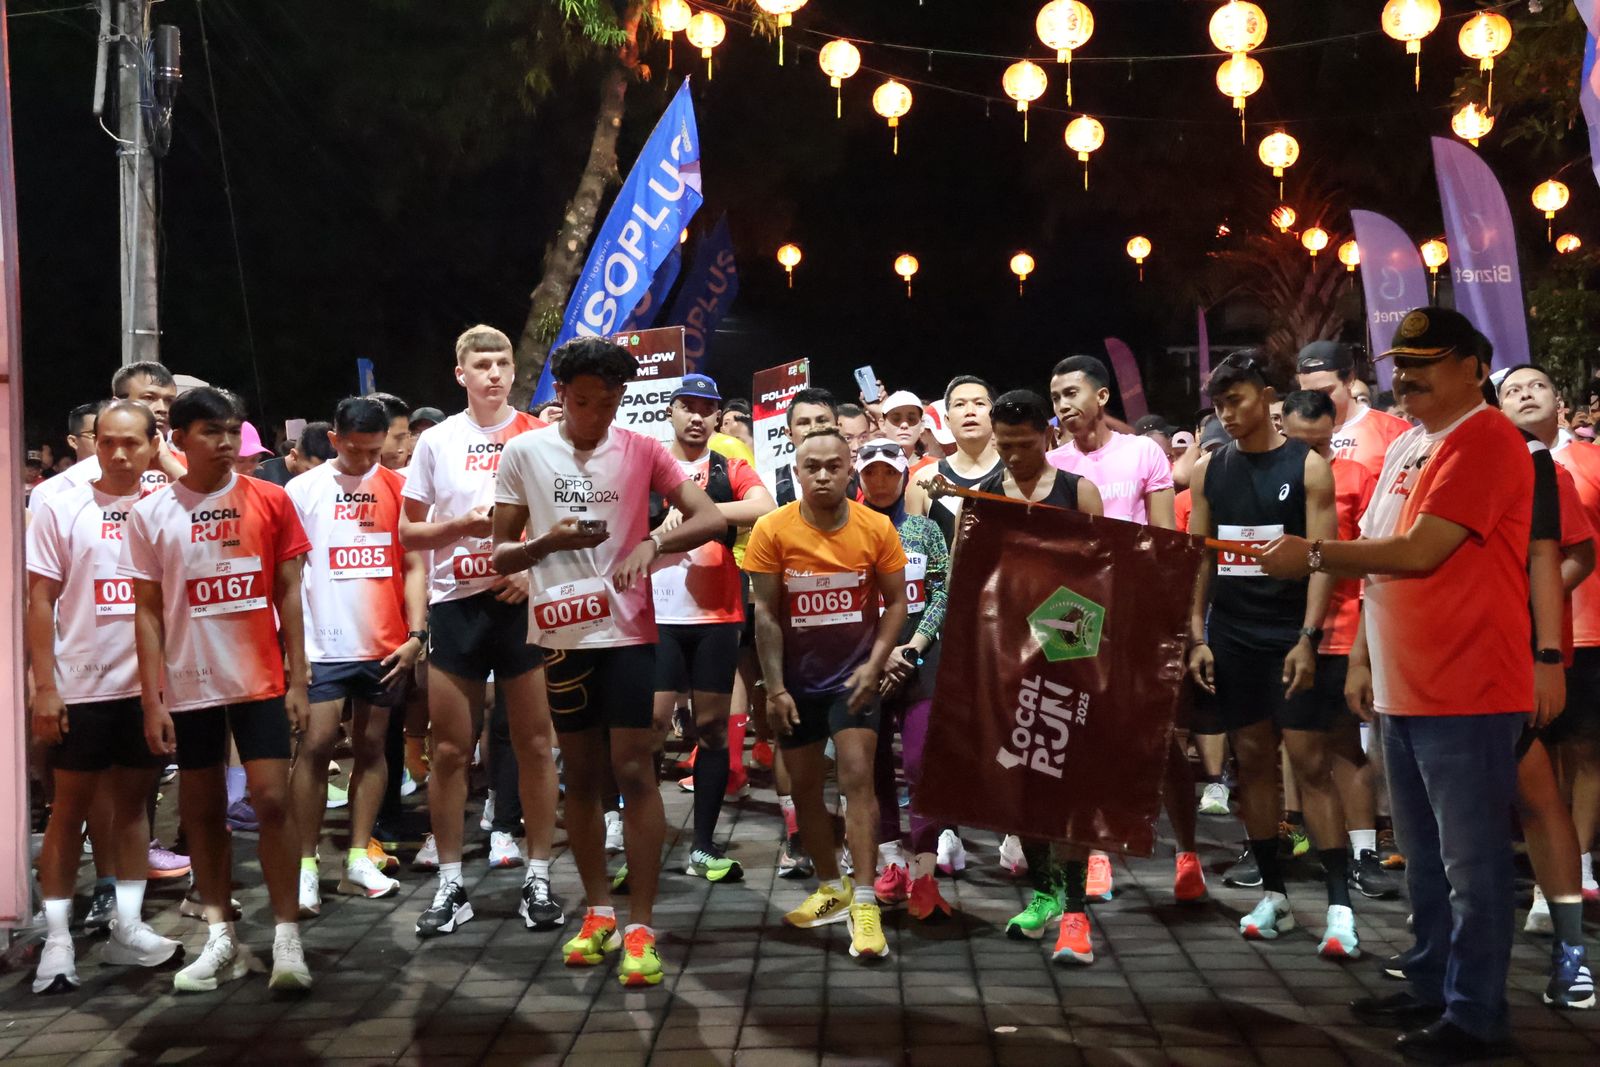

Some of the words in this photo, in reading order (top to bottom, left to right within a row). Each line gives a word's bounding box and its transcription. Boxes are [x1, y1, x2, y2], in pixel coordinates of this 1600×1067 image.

[635, 351, 676, 365] LLOW
[636, 366, 659, 377] ME
[620, 391, 672, 407] PACE
[761, 382, 808, 403] FOLLOW
[767, 425, 787, 441] PA
[467, 443, 504, 454] LOCA
[772, 441, 796, 457] 7.0
[1330, 438, 1358, 448] CAL
[554, 478, 592, 491] OPPO
[336, 493, 378, 503] LOCAL
[191, 507, 241, 523] LOCAL
[334, 503, 377, 521] RUN
[191, 520, 241, 544] RUN
[335, 547, 386, 568] 0085
[102, 581, 135, 602] 00
[196, 575, 255, 602] 0167
[543, 595, 602, 626] 0076
[797, 590, 853, 614] 0069
[1075, 691, 1090, 726] 2025
[996, 674, 1041, 770] LOCAL
[1030, 679, 1074, 779] RUN
